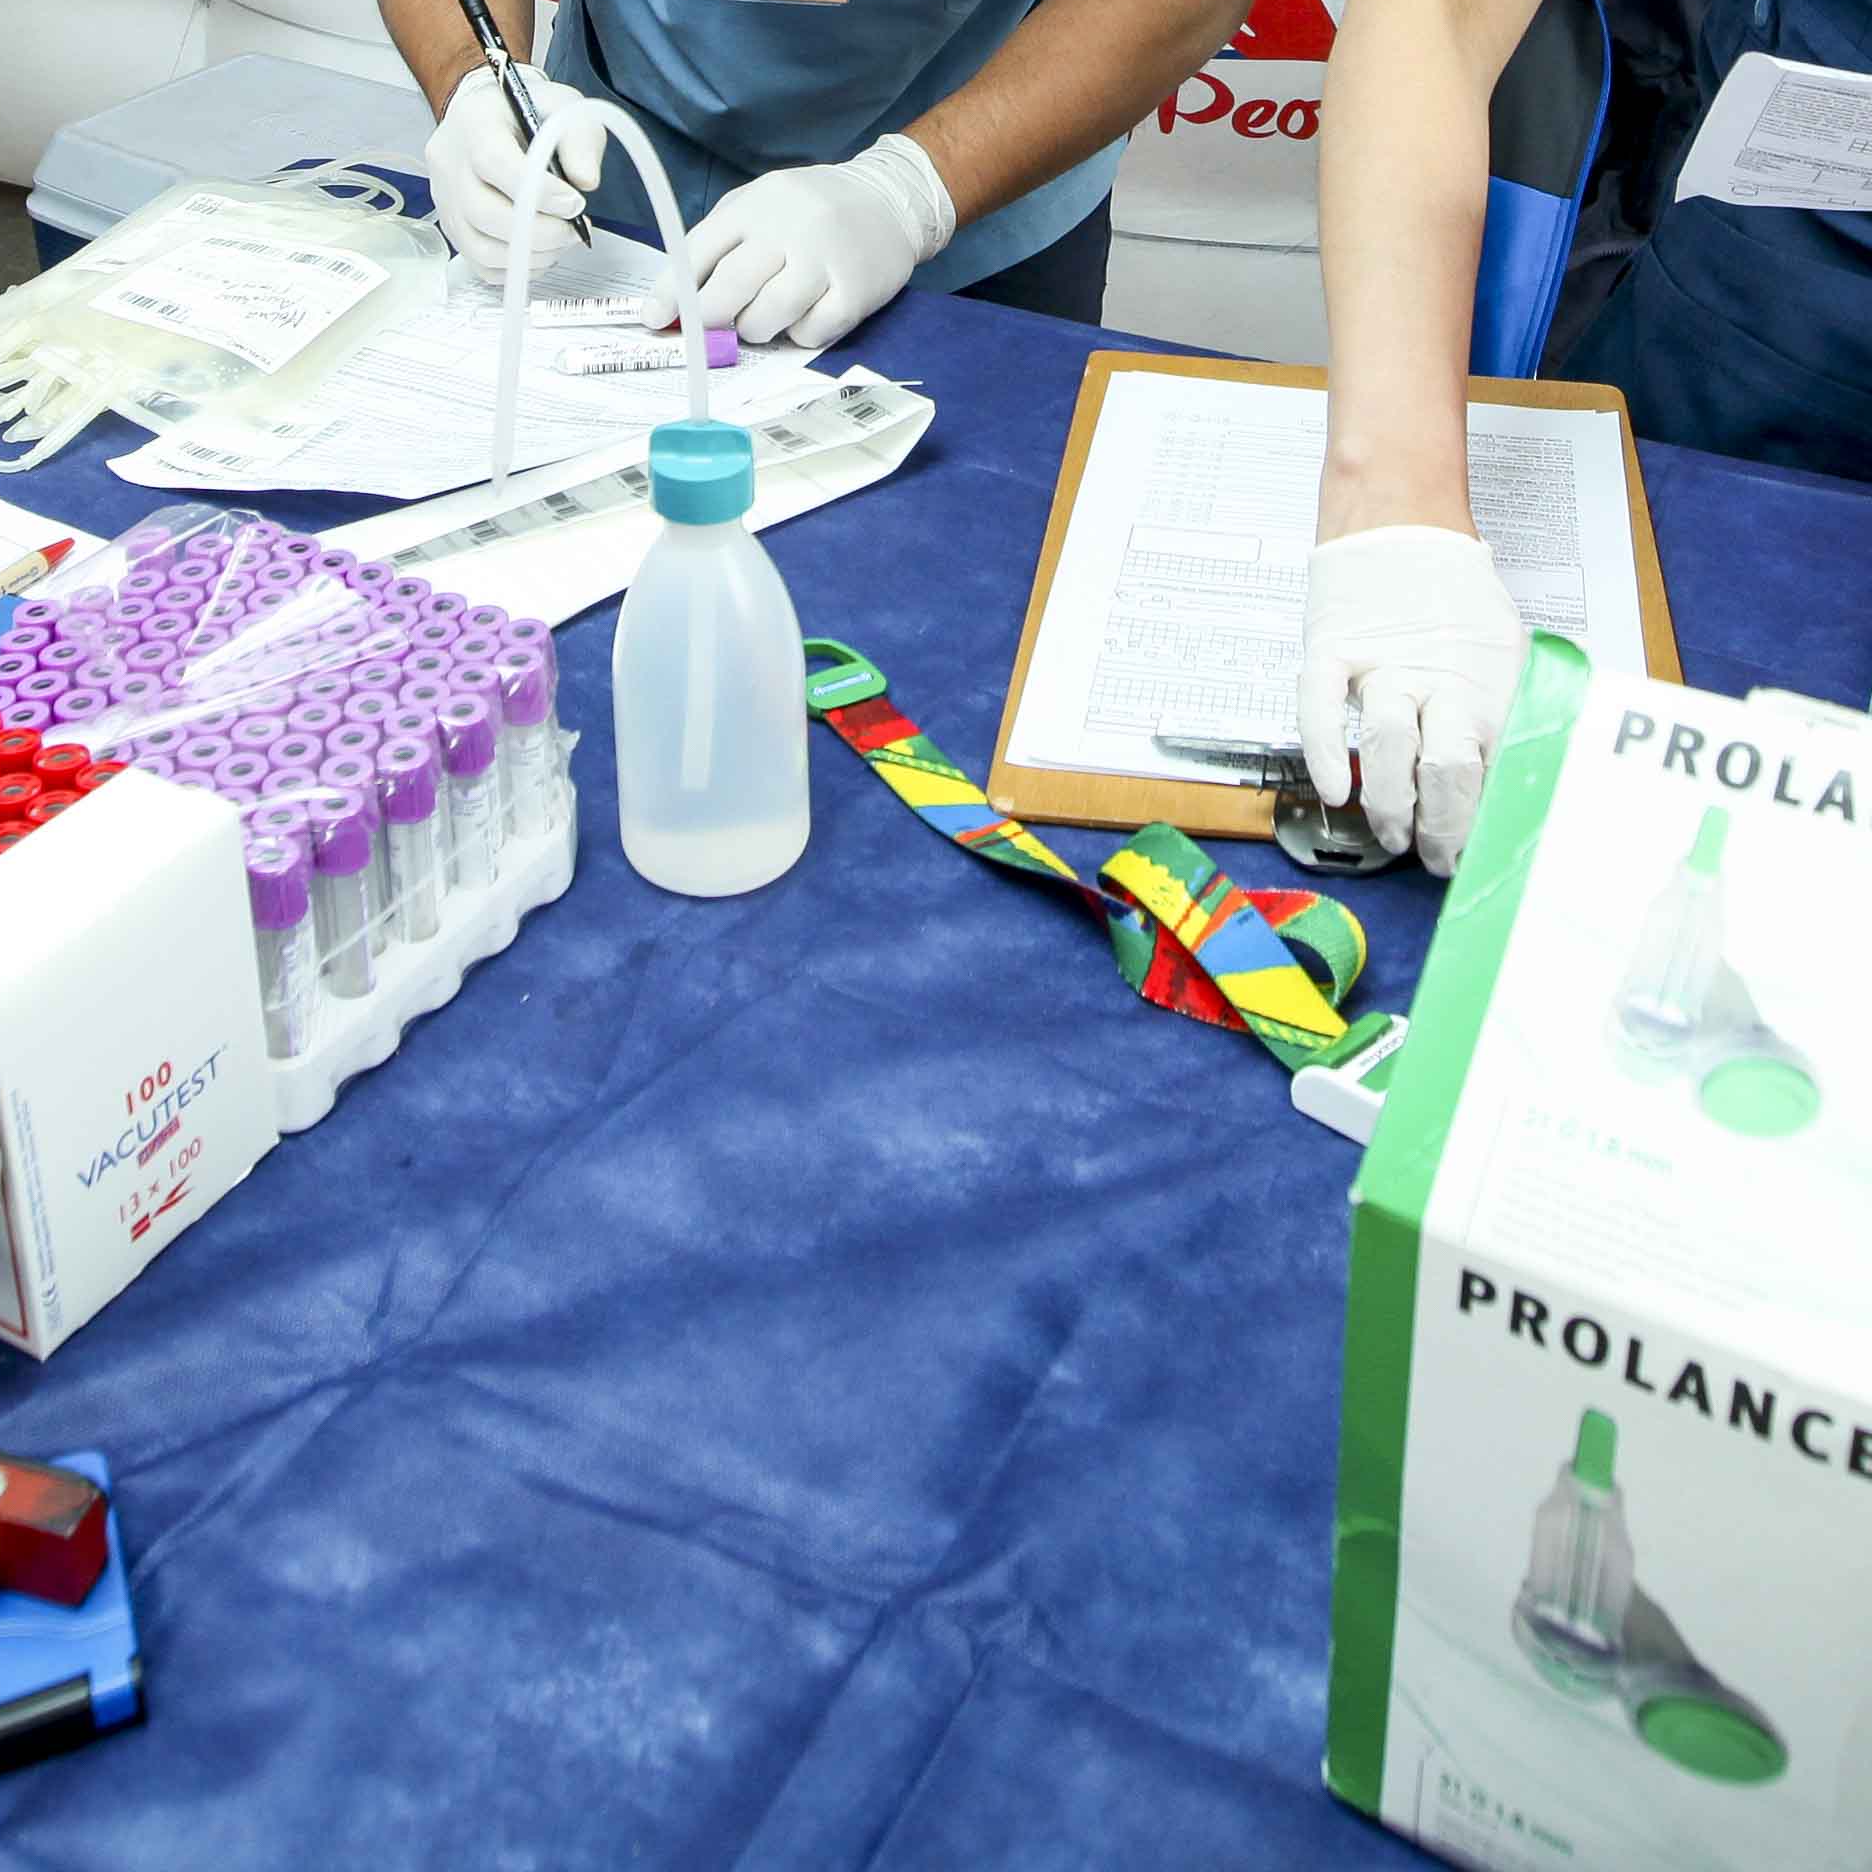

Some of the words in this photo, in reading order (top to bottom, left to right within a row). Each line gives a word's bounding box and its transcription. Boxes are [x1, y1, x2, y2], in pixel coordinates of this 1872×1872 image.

[1156, 70, 1322, 141] Peo
[77, 1048, 221, 1190] VACUTEST
[125, 1061, 173, 1116] 100
[169, 1137, 202, 1179] 100
